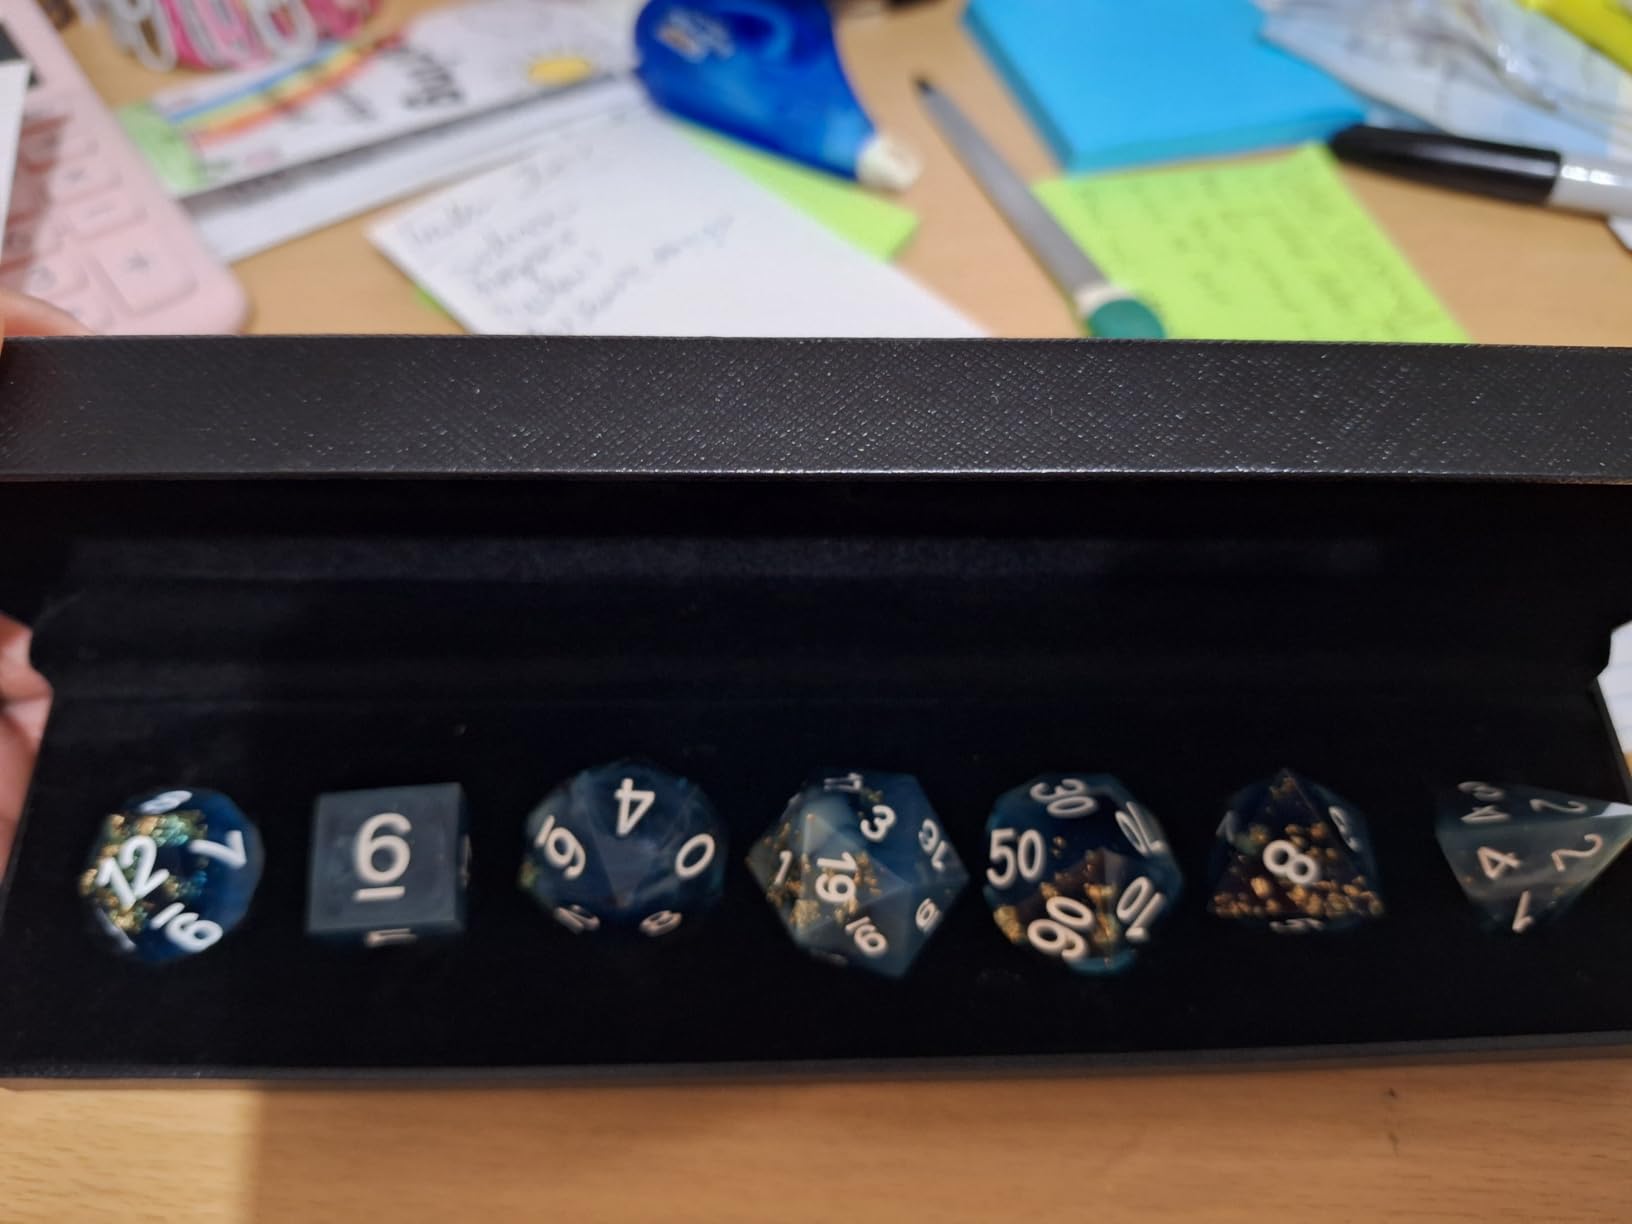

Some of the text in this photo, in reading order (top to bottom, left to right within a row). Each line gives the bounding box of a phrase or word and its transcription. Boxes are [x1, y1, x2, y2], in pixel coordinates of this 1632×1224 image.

[614, 778, 655, 837] 4
[1030, 778, 1097, 817] 30
[860, 805, 896, 843] 3
[95, 835, 170, 911] 12
[354, 812, 412, 902] 6
[674, 833, 715, 879] 0
[986, 828, 1044, 887] 50
[1263, 840, 1317, 883] 8
[1477, 846, 1520, 878] 4
[1552, 833, 1603, 871] 2
[816, 852, 857, 902] 19
[1028, 895, 1095, 959] 90
[1117, 877, 1165, 941] 10
[1512, 888, 1533, 932] 1
